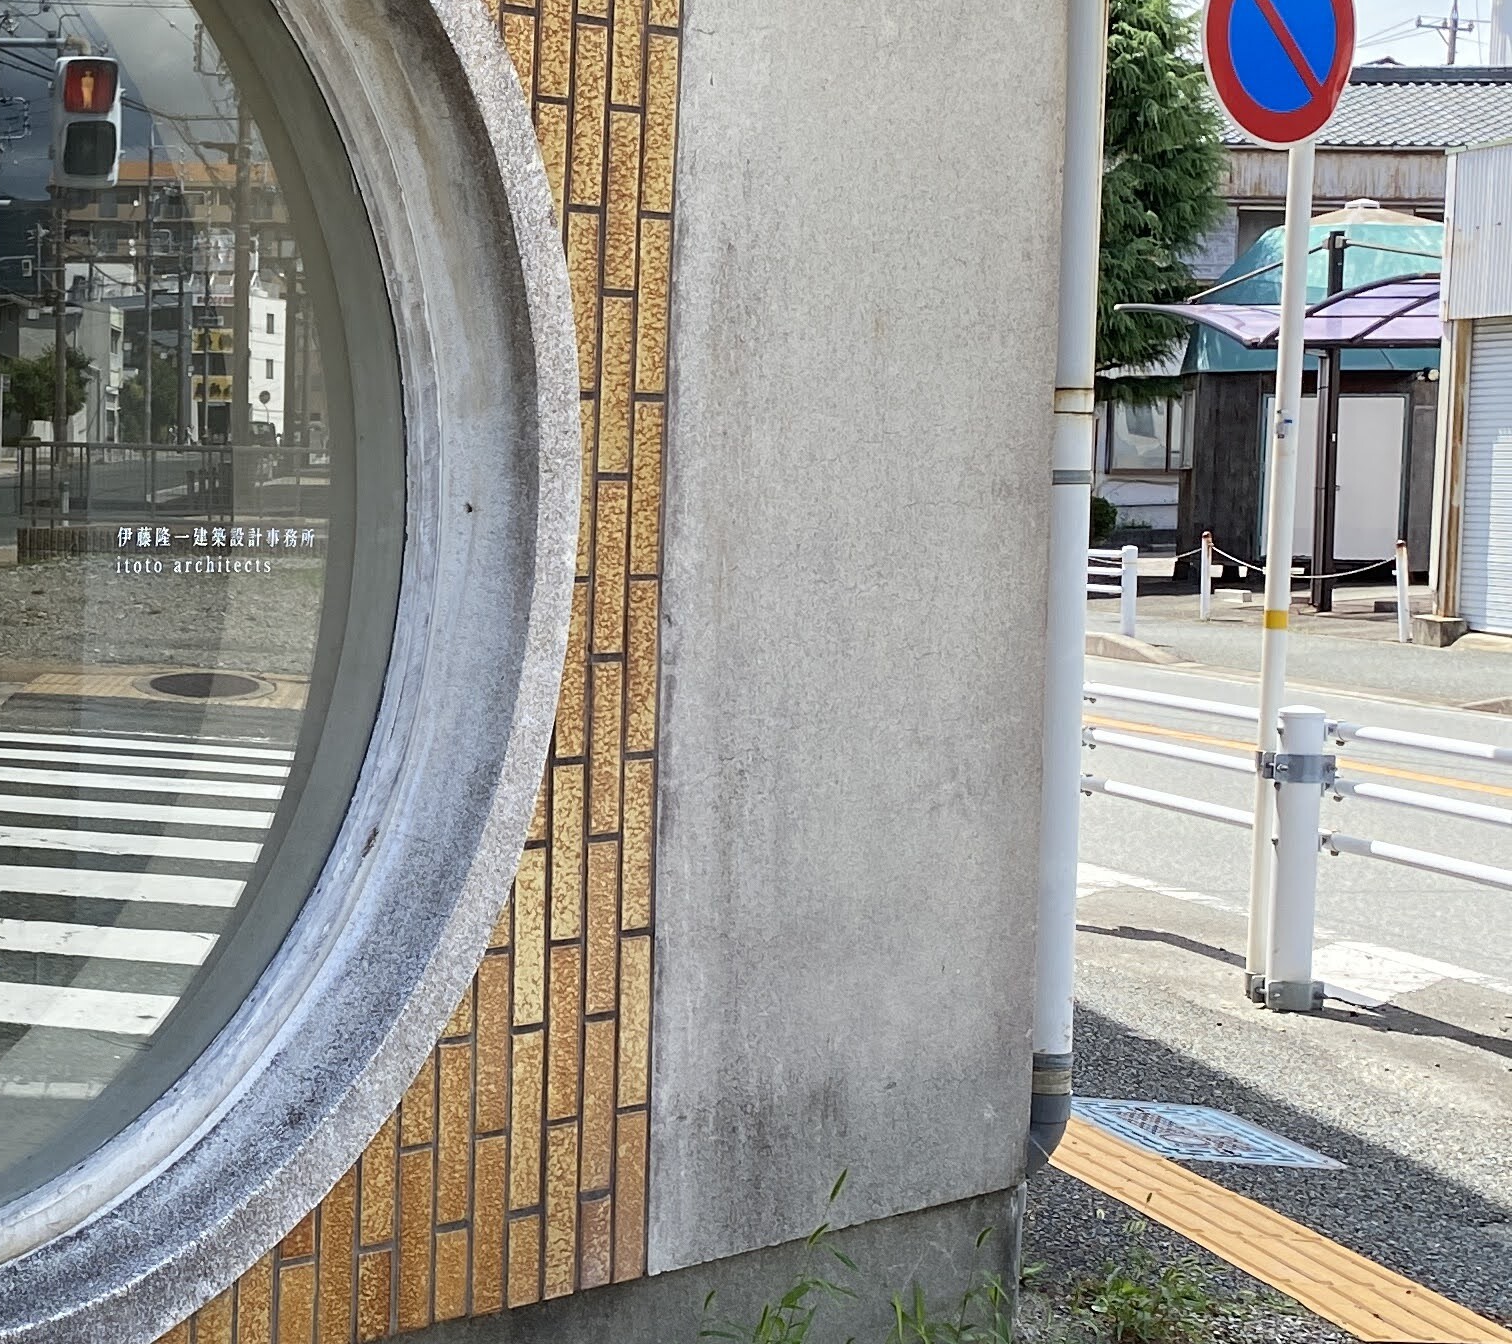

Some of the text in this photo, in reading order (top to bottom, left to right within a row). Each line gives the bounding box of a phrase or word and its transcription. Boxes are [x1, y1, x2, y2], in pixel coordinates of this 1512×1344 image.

[116, 526, 316, 548] 伊藤隆一建築設計事務所
[116, 556, 272, 573] itoto architects
